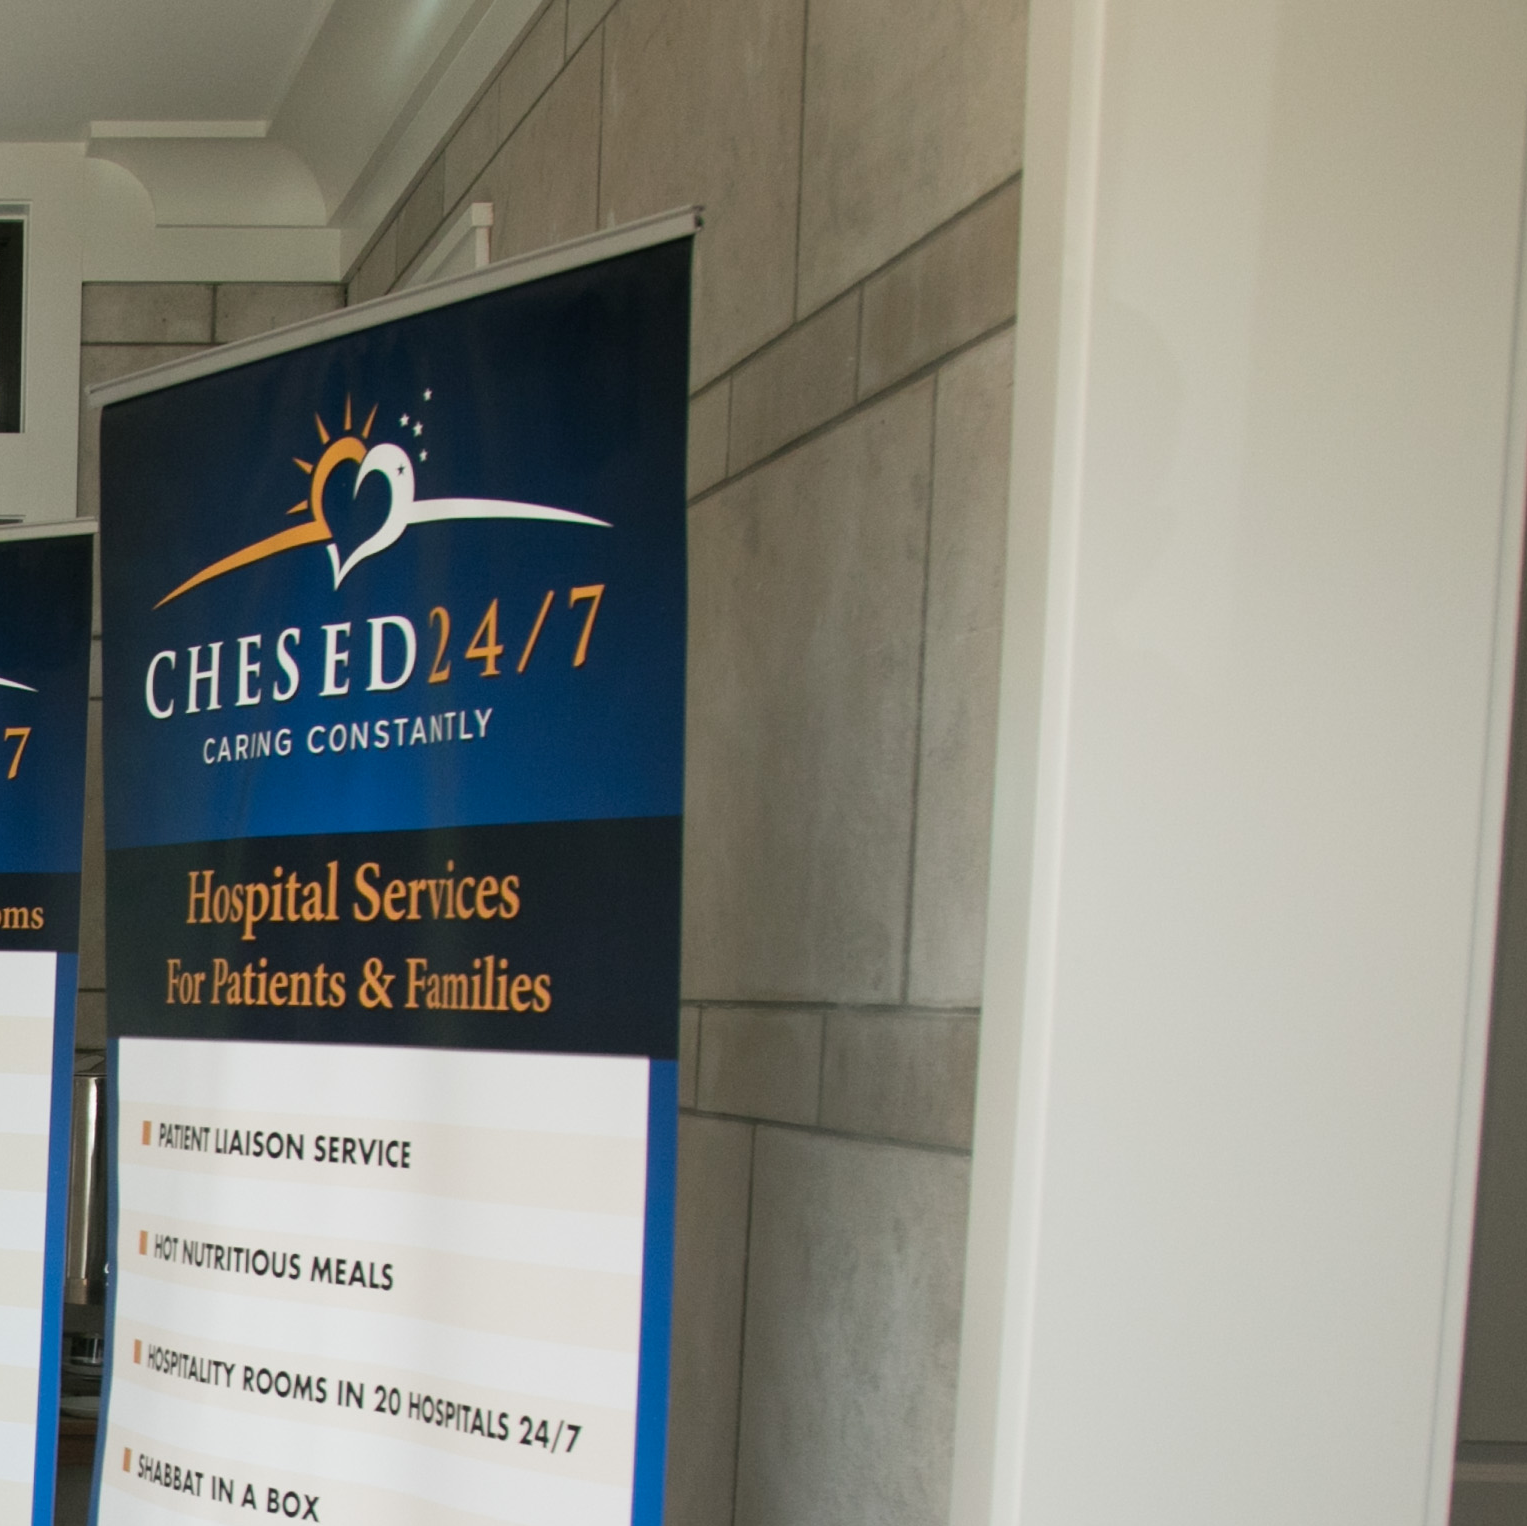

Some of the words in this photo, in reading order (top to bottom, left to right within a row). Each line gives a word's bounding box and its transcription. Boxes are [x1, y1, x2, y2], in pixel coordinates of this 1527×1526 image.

[203, 728, 292, 764] CARING
[307, 708, 492, 753] CONSTANTLY
[187, 861, 339, 940] Hospital
[354, 860, 520, 921] Services
[166, 959, 206, 1004] For
[211, 958, 346, 1007] Patients
[359, 957, 395, 1008] &
[405, 955, 551, 1012] Families
[159, 1123, 210, 1151] PATIENT
[215, 1129, 304, 1160] LIAISON
[314, 1135, 410, 1168] SERVICE
[155, 1236, 178, 1261] HOT
[183, 1240, 301, 1280] NUTRITIOUS
[310, 1256, 393, 1291] MEALS
[148, 1345, 235, 1387] HOSPITALITY
[243, 1366, 327, 1403] ROOMS
[338, 1380, 364, 1409] IN
[374, 1385, 401, 1416] 20
[409, 1392, 509, 1441] HOSPITALS
[519, 1415, 581, 1453] 24/7
[138, 1454, 204, 1496] SHABBAT
[212, 1476, 233, 1504] IN
[241, 1484, 256, 1509] A
[267, 1488, 319, 1522] BOX
